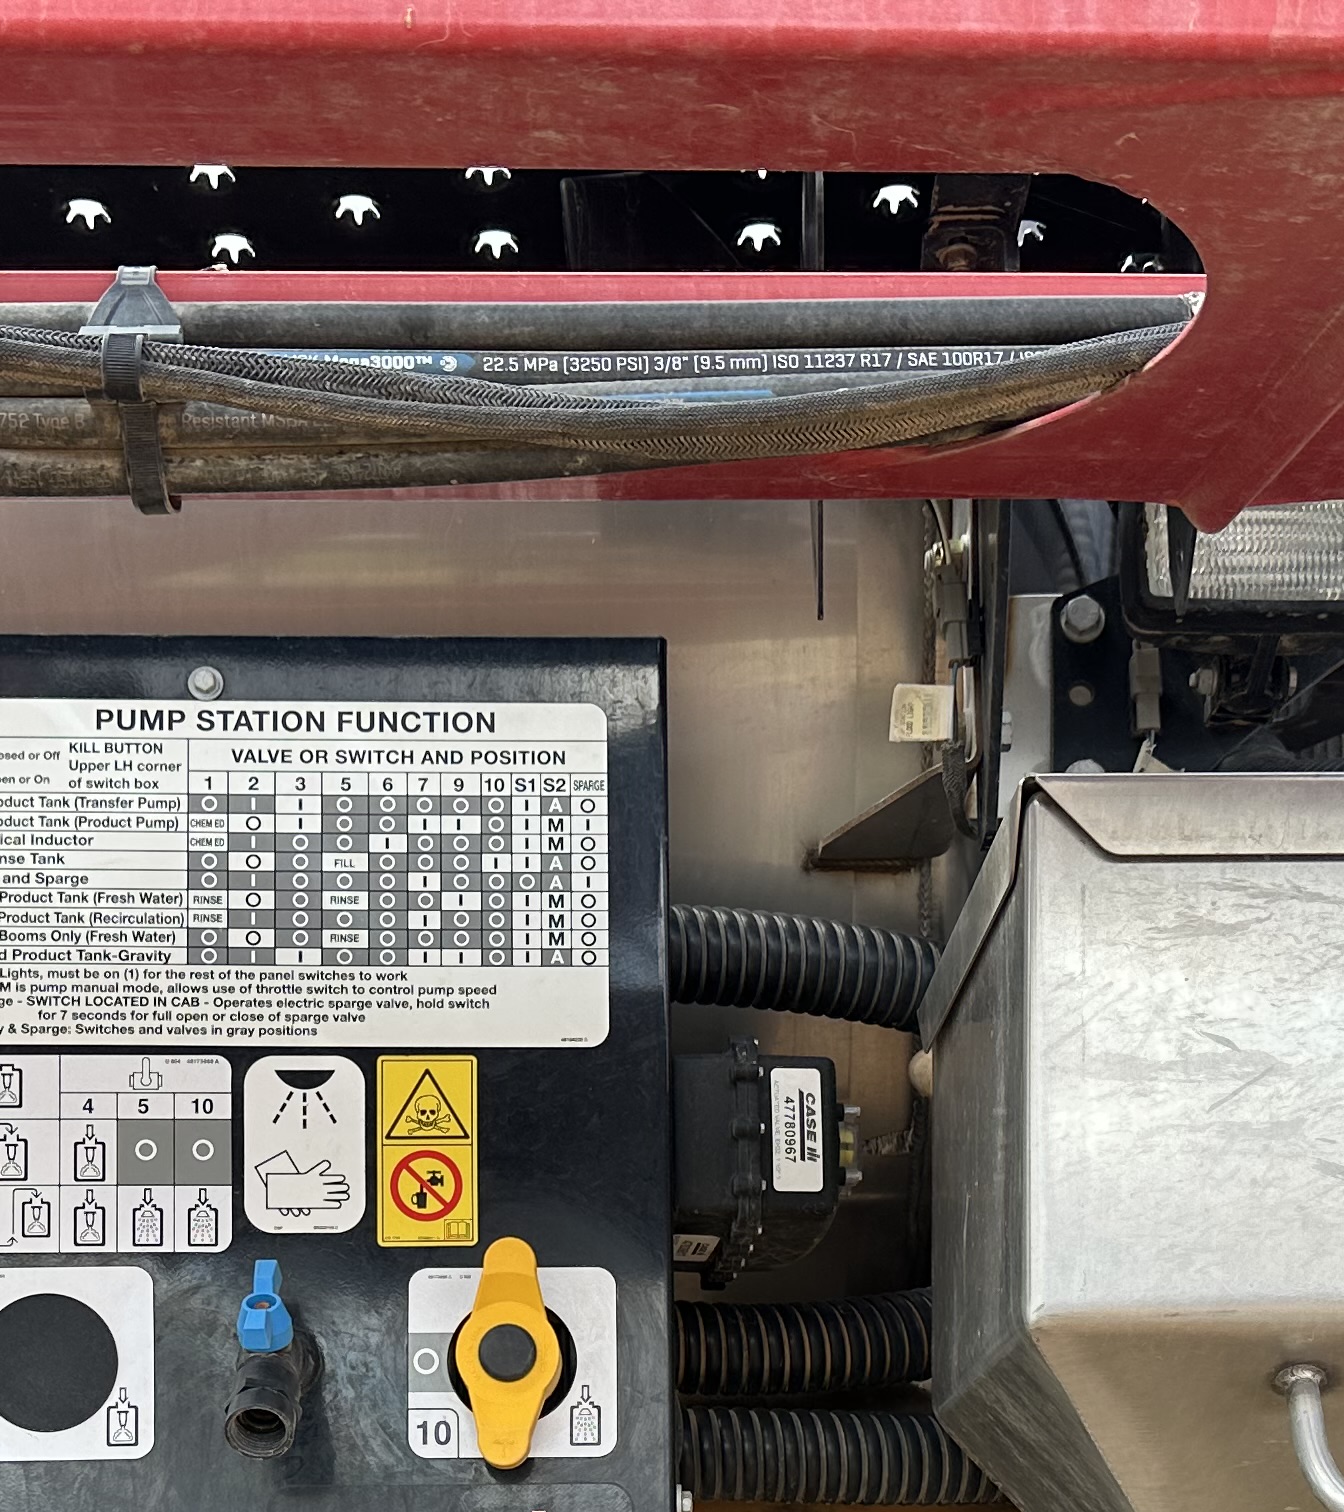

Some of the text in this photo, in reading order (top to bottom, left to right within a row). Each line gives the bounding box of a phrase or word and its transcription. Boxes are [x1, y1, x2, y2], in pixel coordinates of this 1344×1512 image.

[482, 351, 1004, 374] 22.5 MPa [3250 PSI] 3/8" [9.5 mm] ISO 11237 R17 SAE 100R17
[74, 413, 85, 430] B
[181, 412, 259, 429] Resistant
[96, 709, 495, 733] PUMP STATION FUNCTION
[28, 752, 40, 760] or
[43, 750, 60, 760] Off
[69, 742, 163, 754] KILL BUTTON
[232, 748, 566, 765] VALVE OR SWITCH AND POSITION
[69, 760, 182, 774] Upper LH corner
[18, 776, 31, 784] or
[34, 774, 50, 784] On
[68, 777, 159, 789] of switch box
[204, 776, 212, 790] 1
[248, 776, 259, 790] 2
[295, 776, 306, 791] 3
[340, 777, 351, 792] 5
[382, 777, 393, 792] 6
[418, 778, 428, 792] 7
[454, 778, 464, 792] 9
[484, 778, 504, 792] 10
[515, 778, 535, 792] S1
[543, 778, 566, 792] S2
[38, 796, 70, 808] Tank
[74, 796, 134, 811] (Transfer
[138, 797, 180, 812] Pump)
[38, 815, 70, 827] Tank
[74, 816, 132, 830] (Product
[136, 816, 179, 831] Pump)
[31, 834, 94, 846] Inductor
[30, 852, 65, 865] Tank
[334, 858, 355, 868] FILL
[2, 872, 30, 884] and
[35, 872, 89, 888] Sparge
[57, 891, 88, 903] Tank
[93, 892, 135, 906] (Fresh
[139, 892, 183, 907] Water)
[54, 912, 85, 924] Tank
[89, 912, 184, 926] (Recirculation)
[50, 930, 81, 945] Only
[86, 930, 128, 945] (Fresh
[132, 930, 176, 945] Water)
[12, 948, 72, 961] Product
[76, 949, 172, 964] Tank-Gravity
[0, 968, 43, 982] Lights,
[48, 968, 80, 979] must
[84, 968, 100, 979] be
[104, 970, 120, 979] on
[124, 968, 139, 981] (1)
[143, 968, 162, 979] for
[165, 969, 186, 980] the
[190, 970, 214, 980] rest
[218, 970, 231, 980] of
[234, 970, 256, 980] the
[259, 970, 294, 982] panel
[298, 970, 356, 981] switches
[359, 971, 372, 981] to
[376, 970, 408, 981] work
[82, 1098, 214, 1114] 4 5 10
[805, 1092, 817, 1143] CASE
[784, 1096, 797, 1163] 47780967
[416, 1420, 451, 1446] 10
